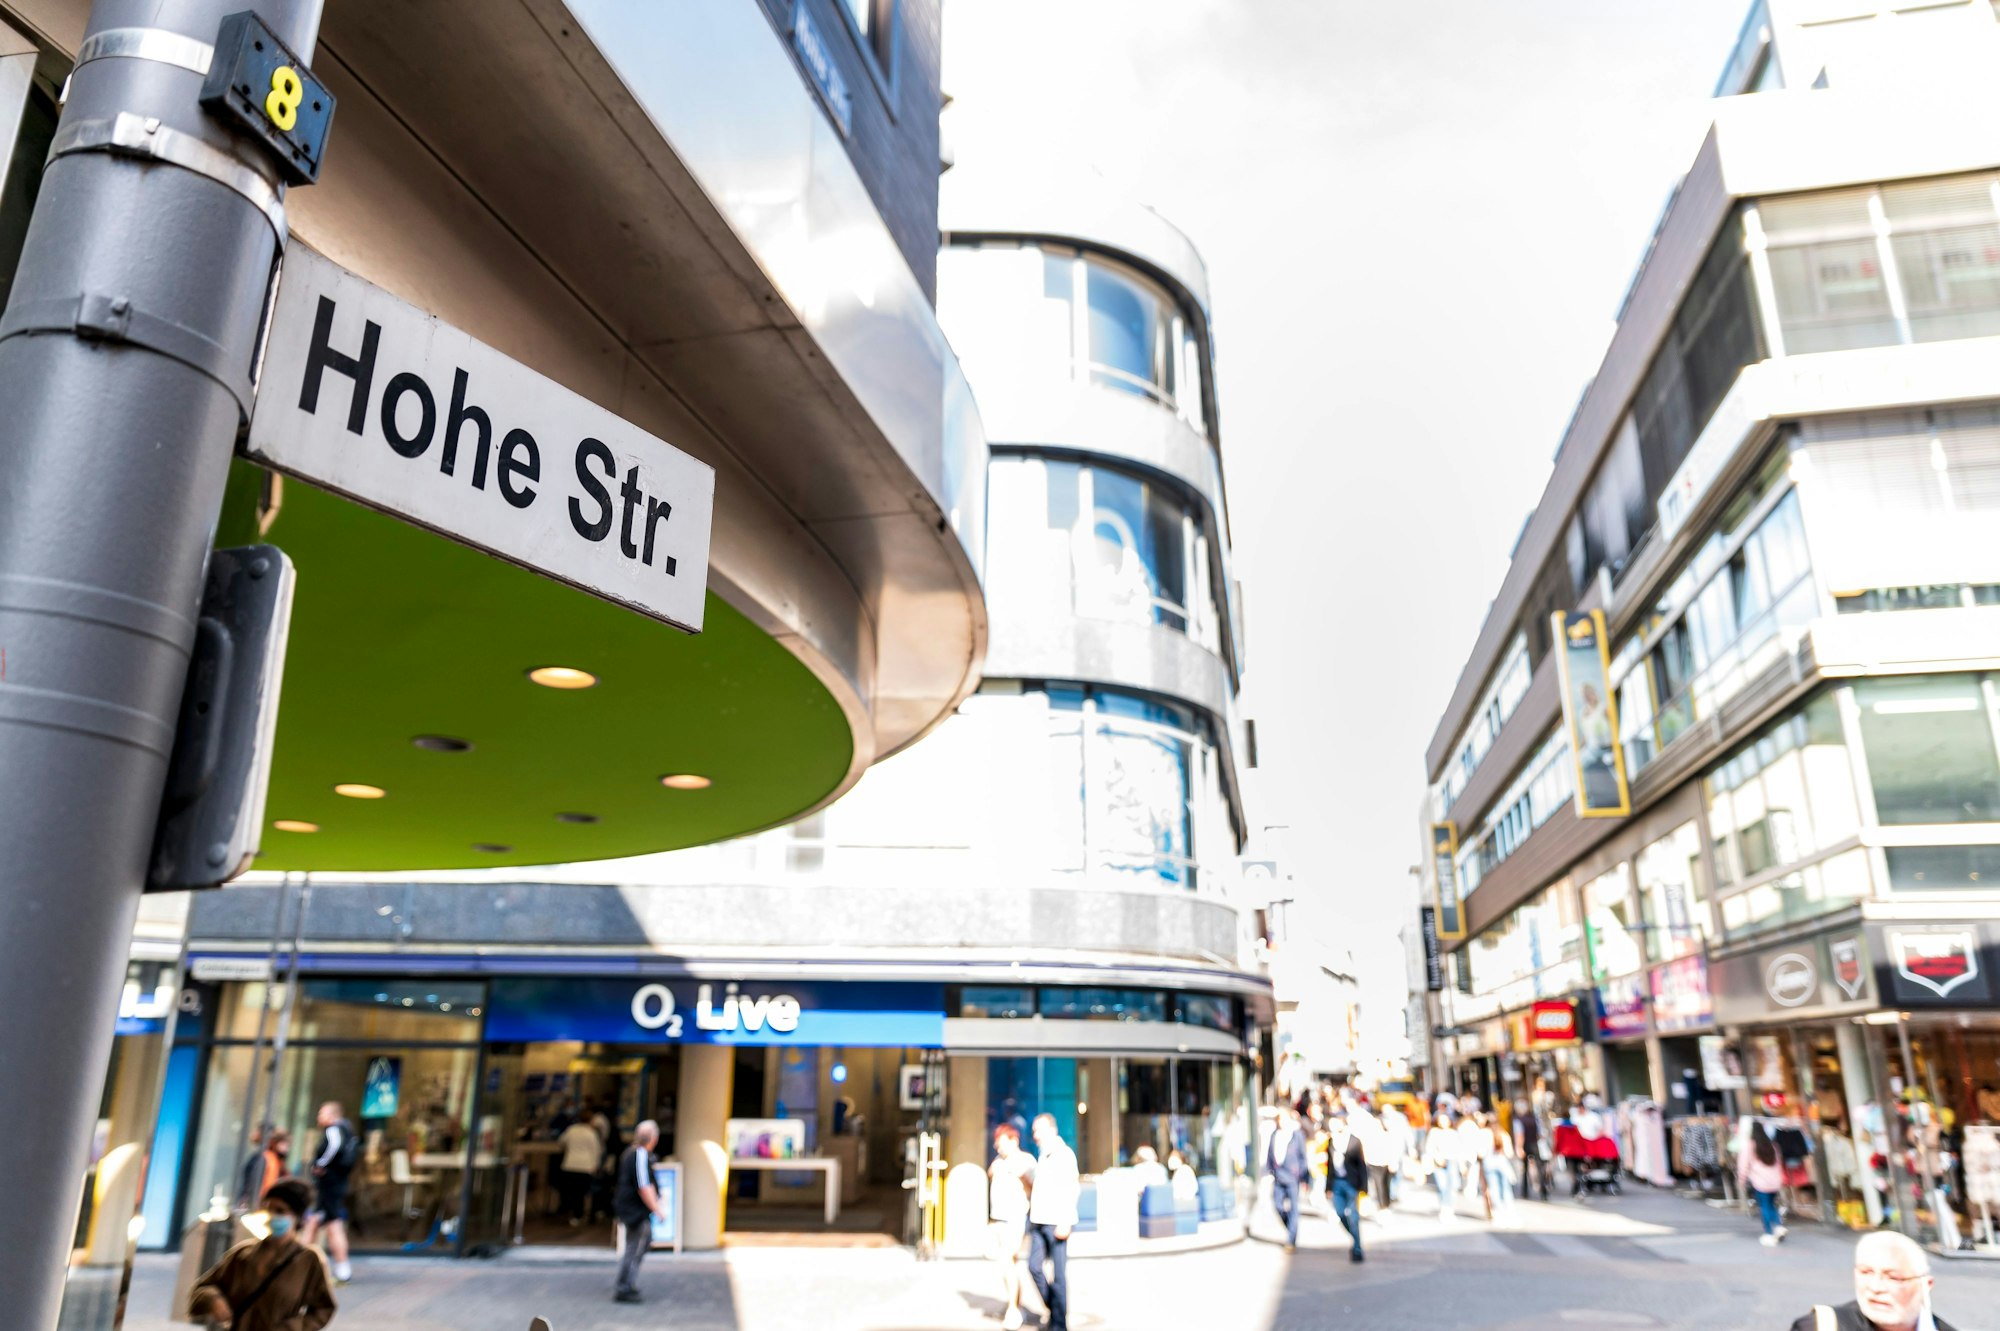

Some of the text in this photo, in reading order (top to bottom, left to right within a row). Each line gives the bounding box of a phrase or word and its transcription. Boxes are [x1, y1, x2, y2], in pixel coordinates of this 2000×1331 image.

[265, 65, 303, 131] 8
[299, 294, 677, 577] Hohe Str.
[696, 983, 801, 1032] Live
